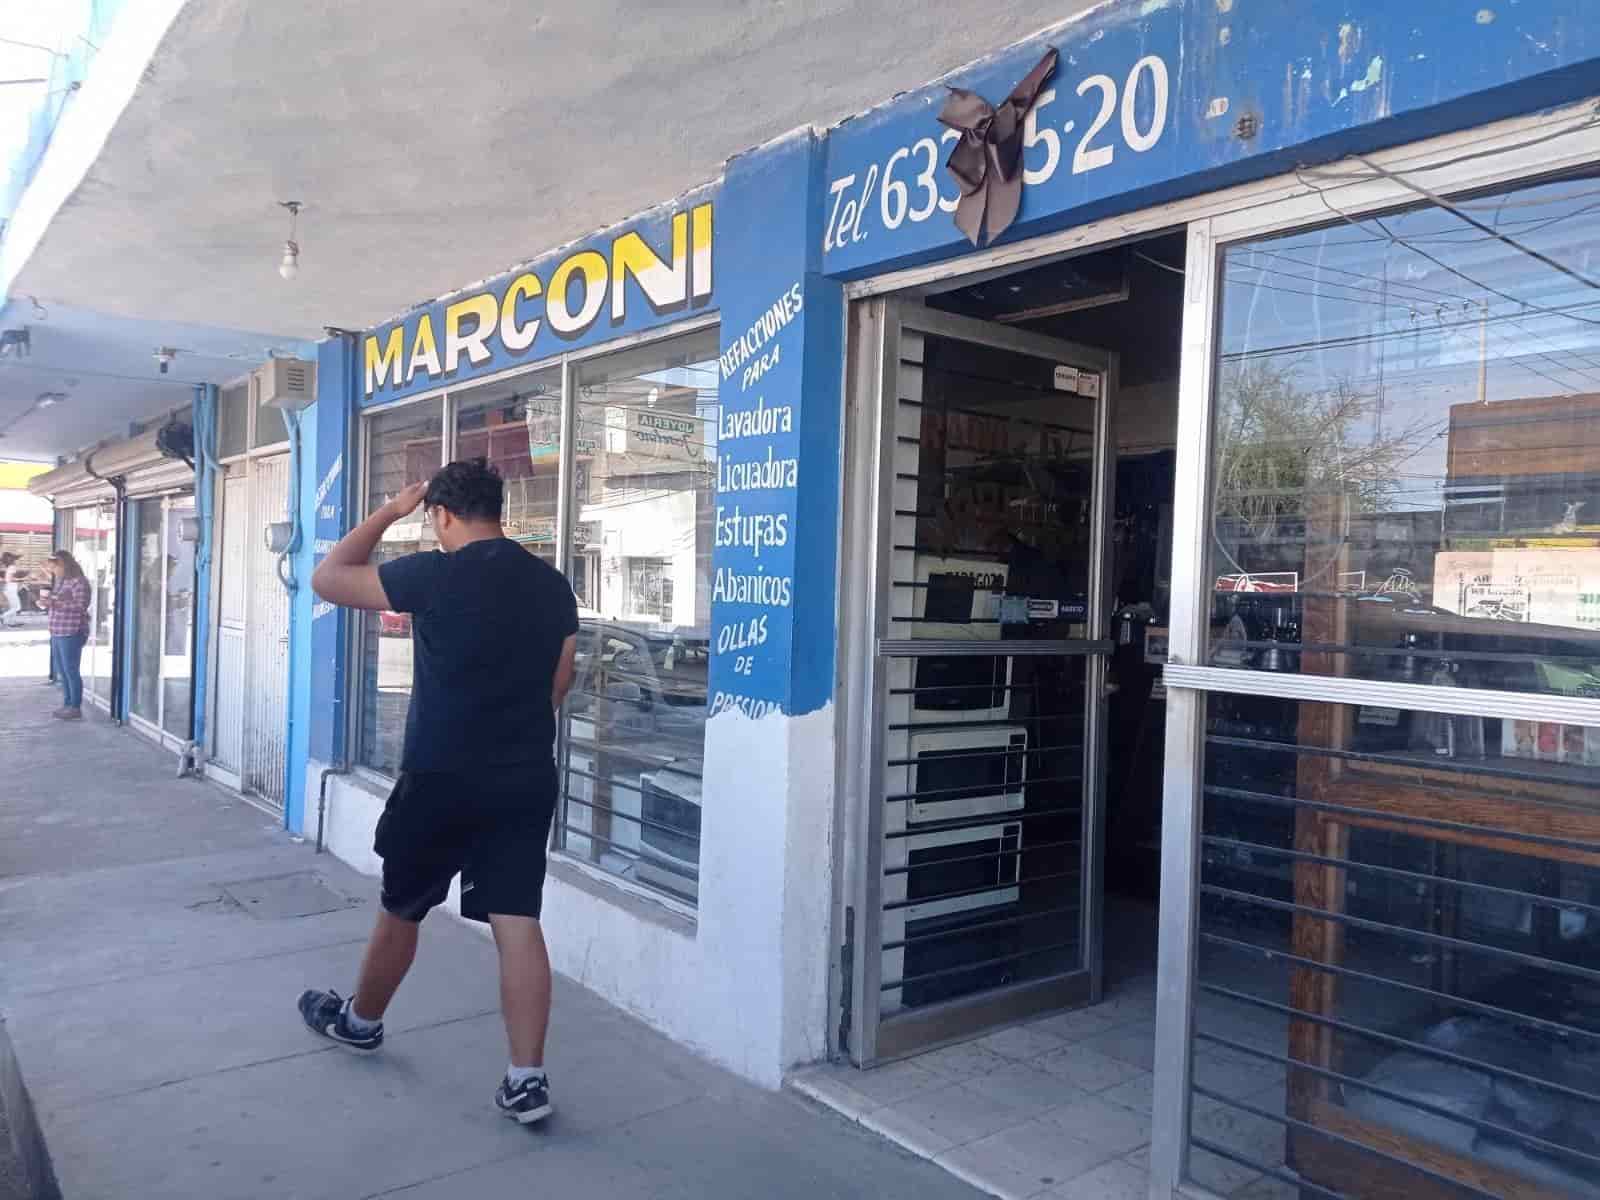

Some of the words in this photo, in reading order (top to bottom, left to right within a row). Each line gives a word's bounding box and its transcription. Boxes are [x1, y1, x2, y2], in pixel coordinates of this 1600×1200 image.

[364, 201, 714, 396] MARCONI
[719, 281, 804, 382] REFACCIONES
[741, 343, 781, 392] PARA
[718, 396, 792, 442] Lavadora
[716, 446, 799, 493] Licuadora
[714, 505, 788, 557] Estufas
[712, 564, 792, 607] Abanicos
[717, 615, 769, 655] OLLAS
[734, 655, 754, 676] DE
